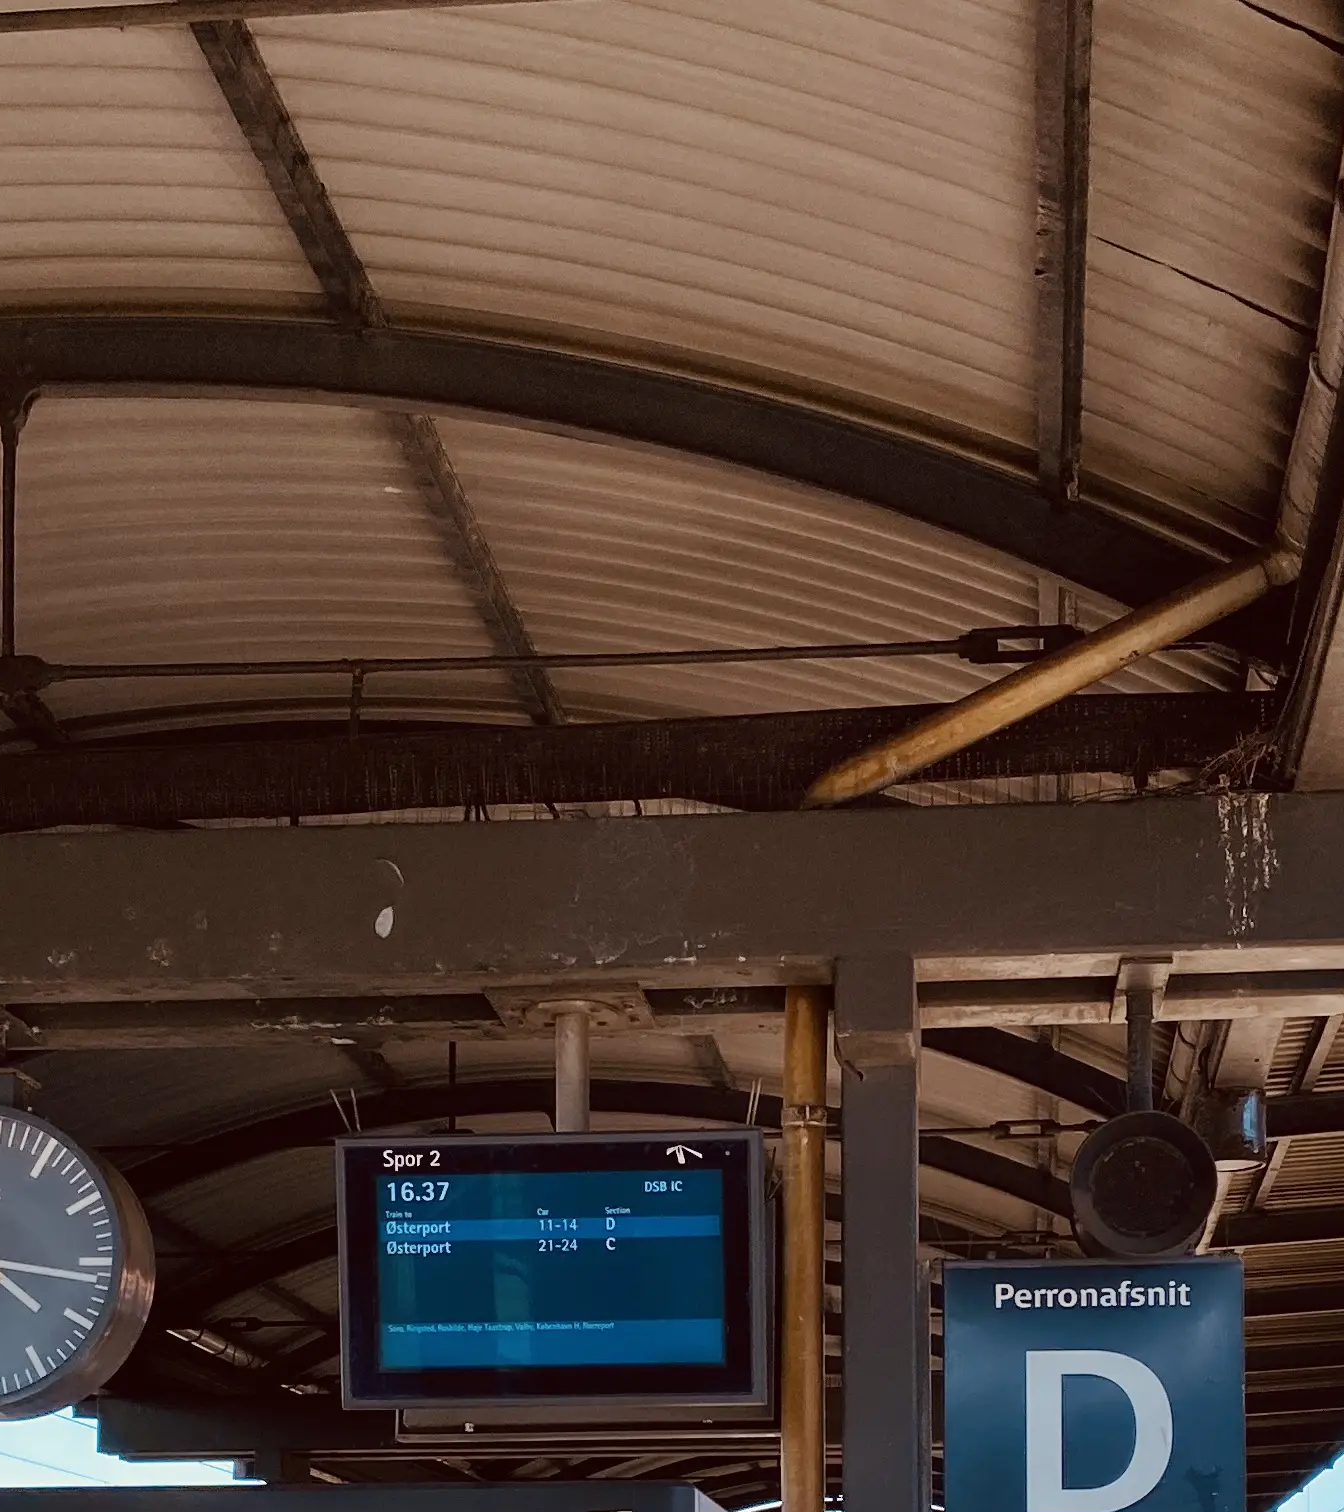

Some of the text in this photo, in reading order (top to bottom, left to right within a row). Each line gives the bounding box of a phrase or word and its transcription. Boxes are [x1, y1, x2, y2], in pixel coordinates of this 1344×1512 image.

[383, 1150, 441, 1171] Spor 2
[387, 1182, 449, 1201] 16.37
[644, 1181, 683, 1192] DSB IC
[386, 1217, 616, 1237] Østerport 11-14 D
[387, 1237, 616, 1257] Østerport 21-24 C
[995, 1281, 1191, 1308] Perronafsnit
